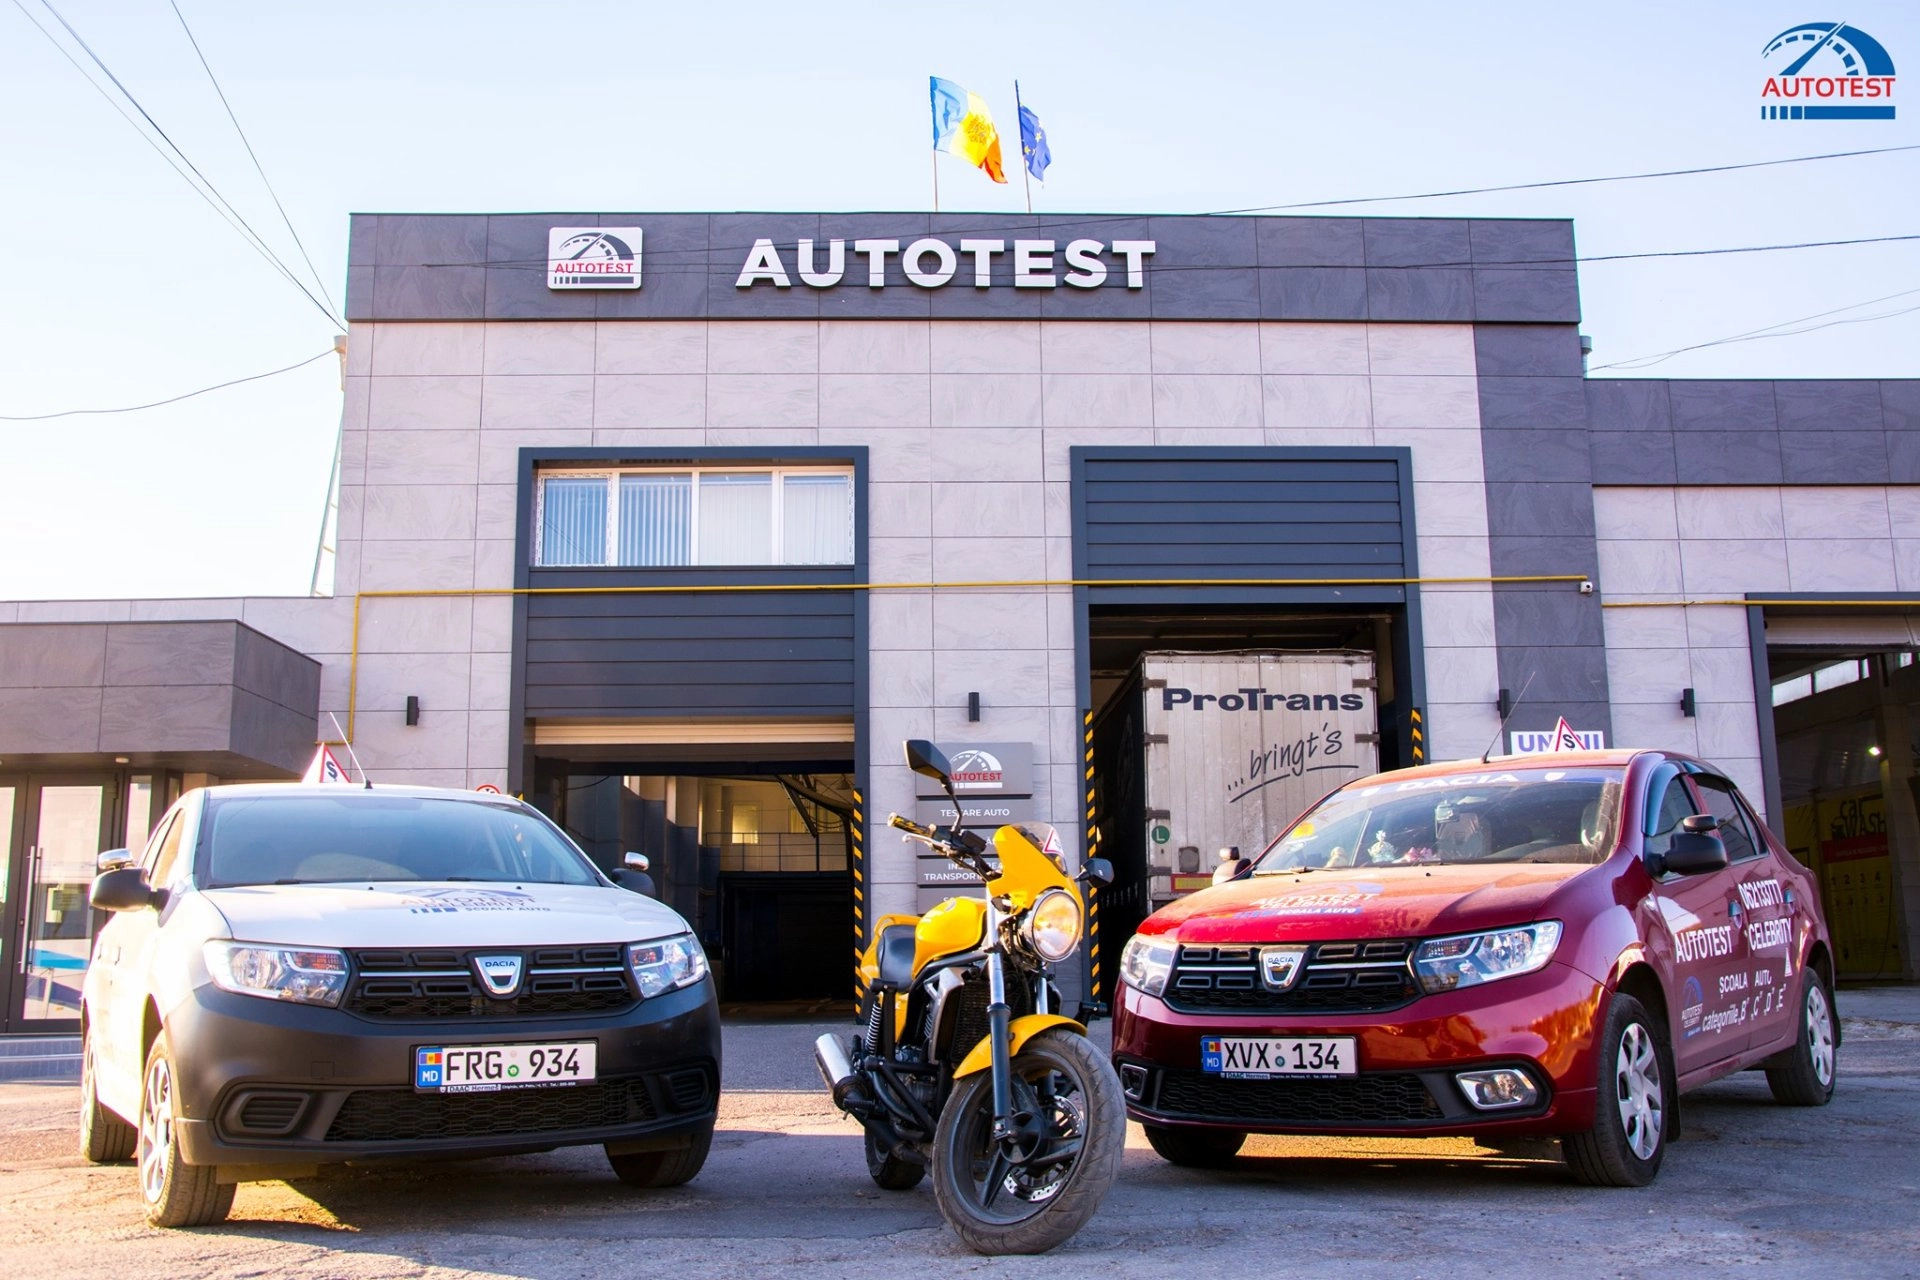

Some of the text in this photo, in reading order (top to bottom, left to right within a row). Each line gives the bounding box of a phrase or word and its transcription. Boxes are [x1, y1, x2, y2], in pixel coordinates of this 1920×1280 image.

[554, 262, 634, 274] AUTOTEST
[735, 238, 1156, 290] AUTOTEST
[1162, 687, 1364, 712] ProTrans
[1396, 774, 1520, 791] DACIA
[940, 808, 1010, 817] TESARE AUTO
[1155, 828, 1165, 842] L
[1674, 918, 1792, 963] AUTOTEST CELEBRITY
[1206, 1058, 1219, 1068] MD
[1224, 1042, 1340, 1069] XVX 134
[446, 1048, 580, 1081] FRG 934
[422, 1070, 438, 1082] MD
